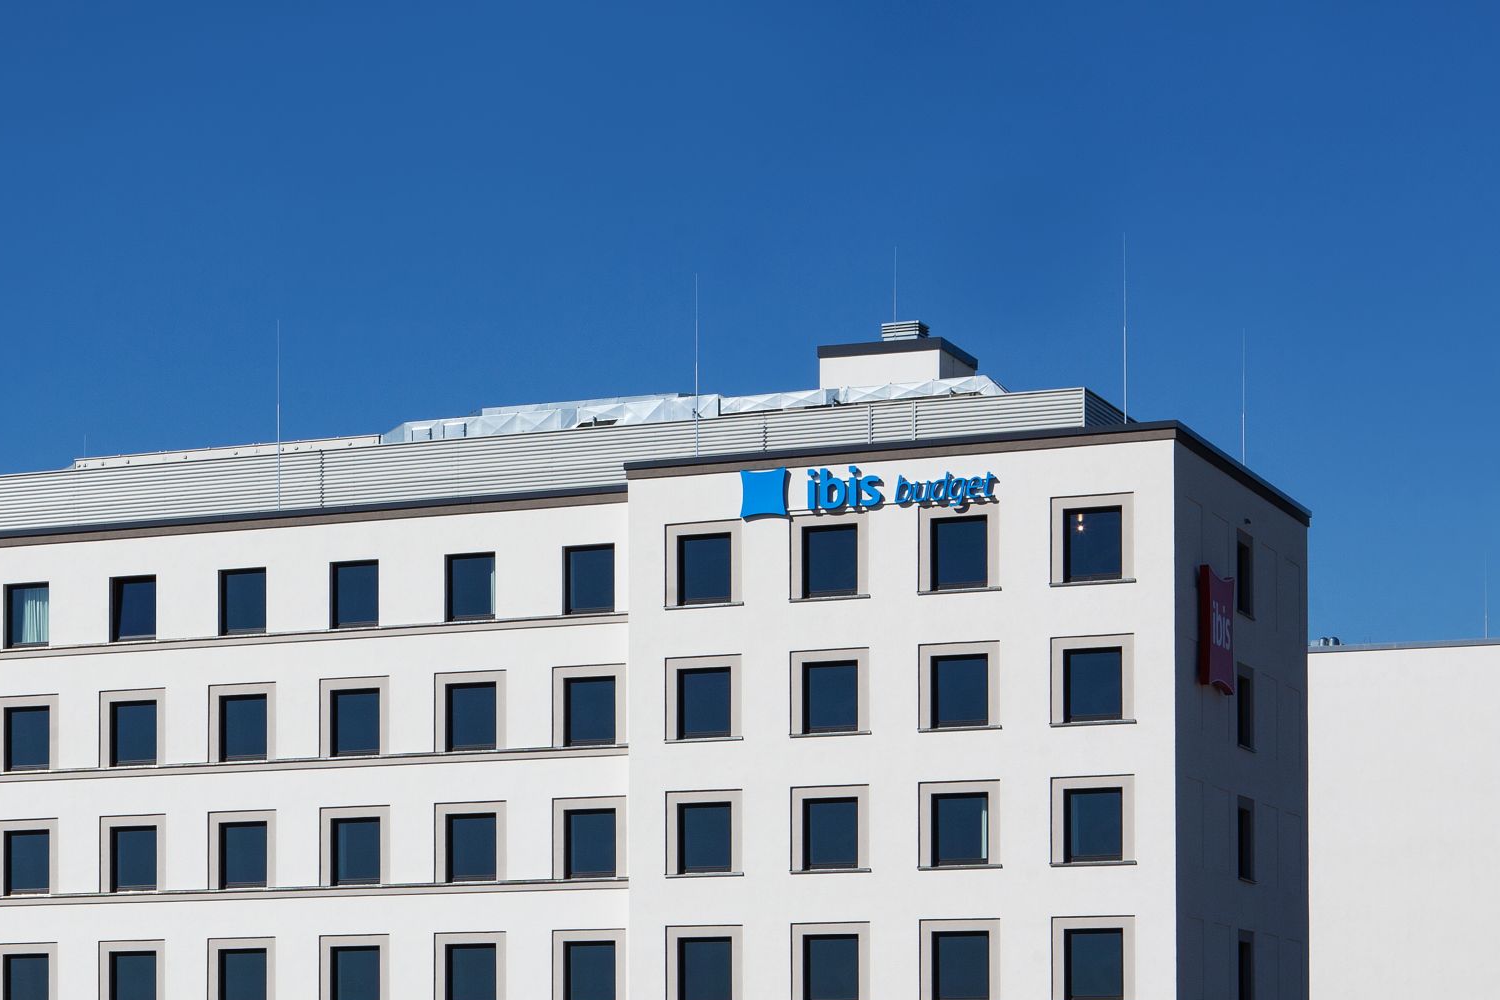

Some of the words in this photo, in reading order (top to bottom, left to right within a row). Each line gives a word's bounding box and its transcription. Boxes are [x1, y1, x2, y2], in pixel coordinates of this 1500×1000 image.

[807, 465, 884, 510] ibis
[894, 471, 997, 507] budget
[1212, 599, 1231, 651] ibis
